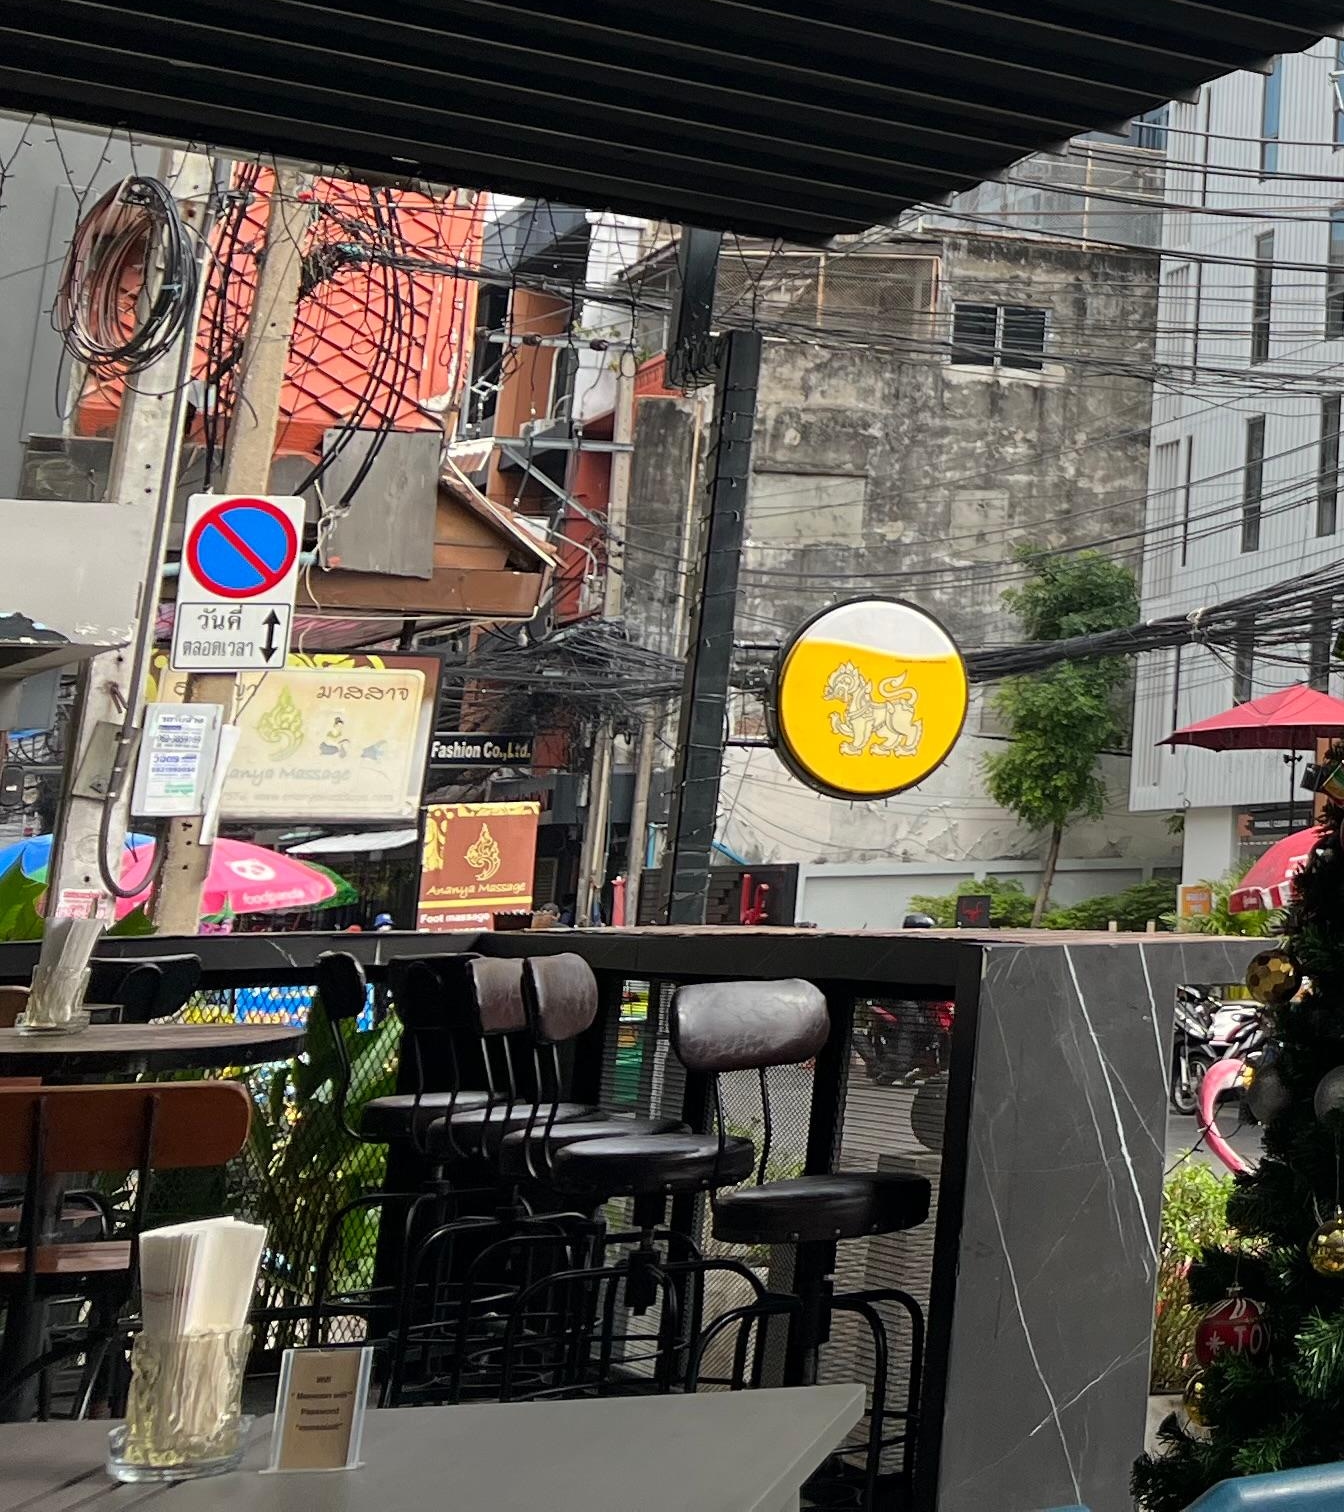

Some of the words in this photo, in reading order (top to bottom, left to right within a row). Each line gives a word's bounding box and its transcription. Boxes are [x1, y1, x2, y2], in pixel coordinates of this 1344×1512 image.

[198, 605, 243, 630] วันคี่
[182, 640, 254, 657] ตลอดเวลา
[431, 740, 481, 758] Fashion
[426, 884, 476, 899] Ananya
[478, 882, 527, 895] Massage
